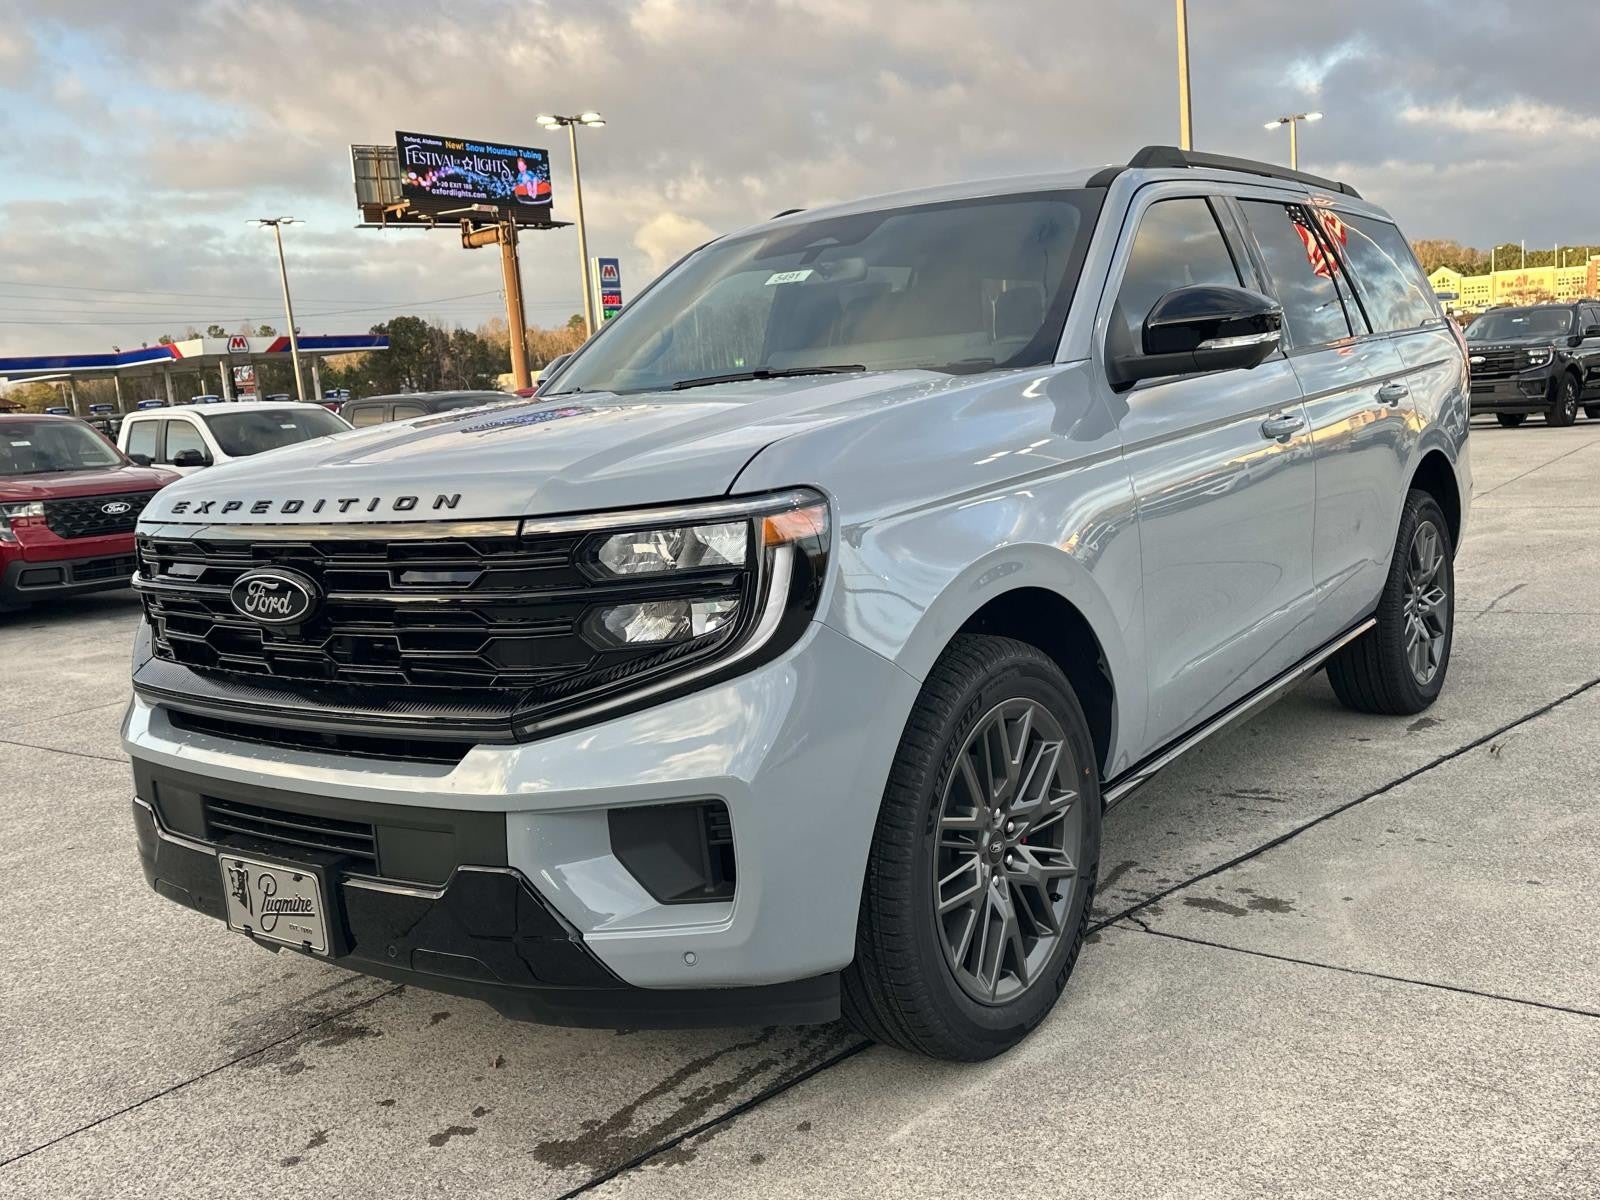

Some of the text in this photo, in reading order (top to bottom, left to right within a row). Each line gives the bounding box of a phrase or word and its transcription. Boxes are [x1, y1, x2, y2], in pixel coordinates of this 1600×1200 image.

[403, 136, 442, 146] Oxford, Alabama
[445, 141, 542, 160] New! Snow Mountain Tubing
[405, 145, 454, 167] FESTIVAL
[474, 155, 511, 181] LIGHTS
[431, 188, 487, 199] oxfordlights.com
[171, 493, 462, 515] EXPEDITION
[245, 580, 293, 616] Ford
[933, 693, 982, 800] MICHELIN
[258, 872, 315, 933] Pugmire
